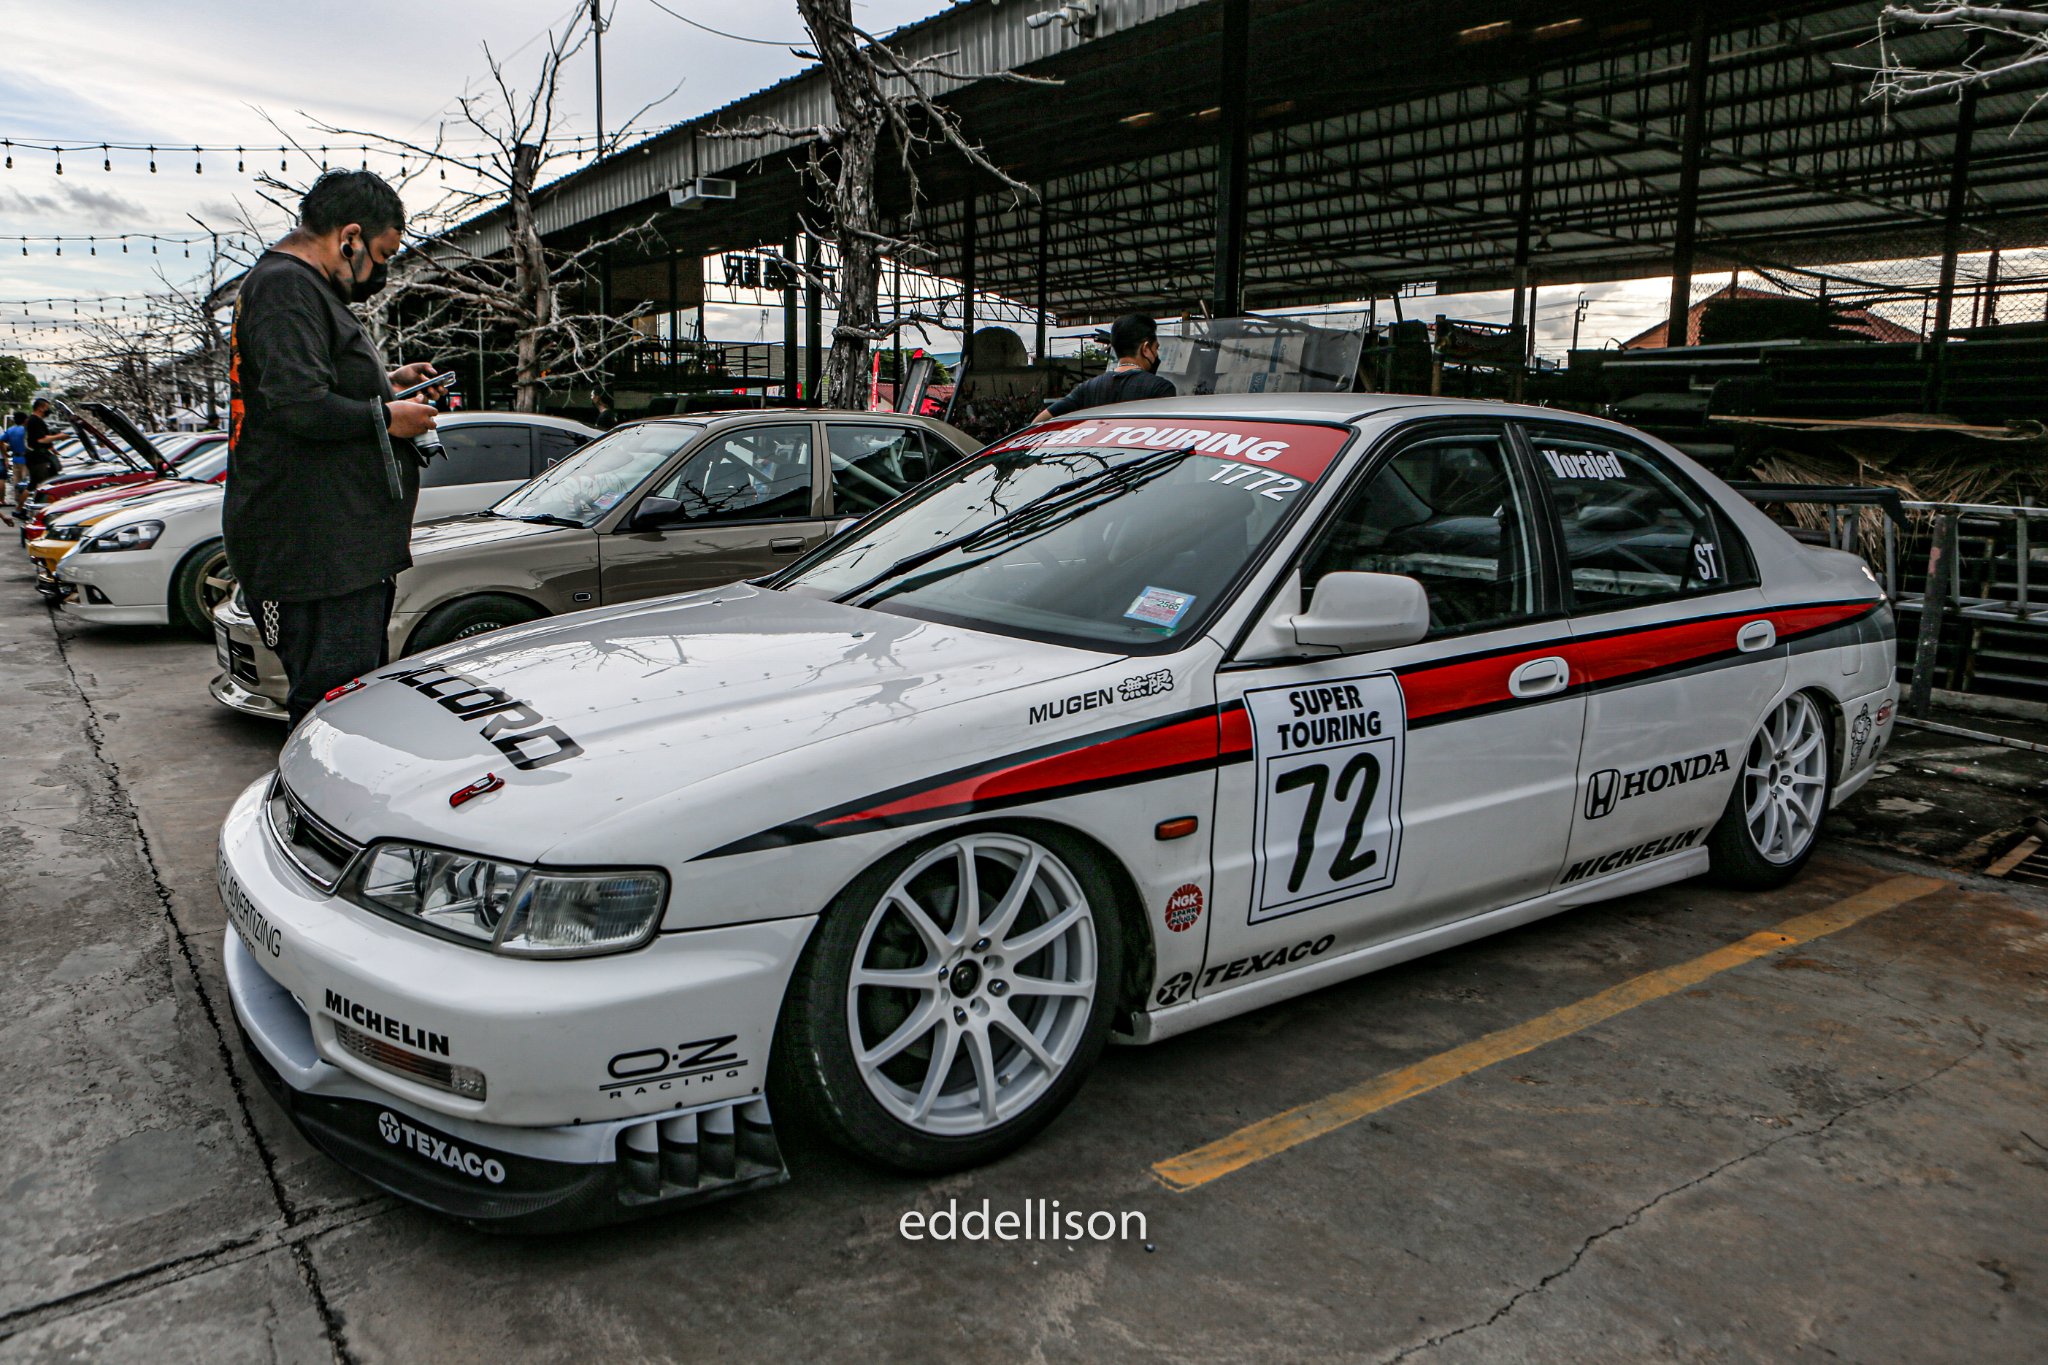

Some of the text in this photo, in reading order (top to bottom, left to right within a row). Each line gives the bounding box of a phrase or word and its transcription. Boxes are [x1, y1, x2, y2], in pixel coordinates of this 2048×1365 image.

[1099, 427, 1290, 461] TOURING
[1208, 463, 1303, 501] 1772
[1542, 450, 1626, 480] Vorajed
[1694, 543, 1718, 580] ST
[1157, 600, 1181, 611] 2565
[1117, 669, 1174, 702] 無限
[1289, 685, 1363, 717] SUPER
[1029, 687, 1113, 725] MUGEN
[1277, 711, 1381, 750] TOURING
[1620, 749, 1730, 800] HONDA
[1275, 752, 1380, 893] 72
[1560, 827, 1703, 884] MICHELIN
[1171, 892, 1198, 909] NGK
[1203, 934, 1336, 988] TEXACO
[325, 988, 450, 1056] MICHELIN
[609, 1070, 738, 1099] RACING
[401, 1122, 506, 1184] TEXACO
